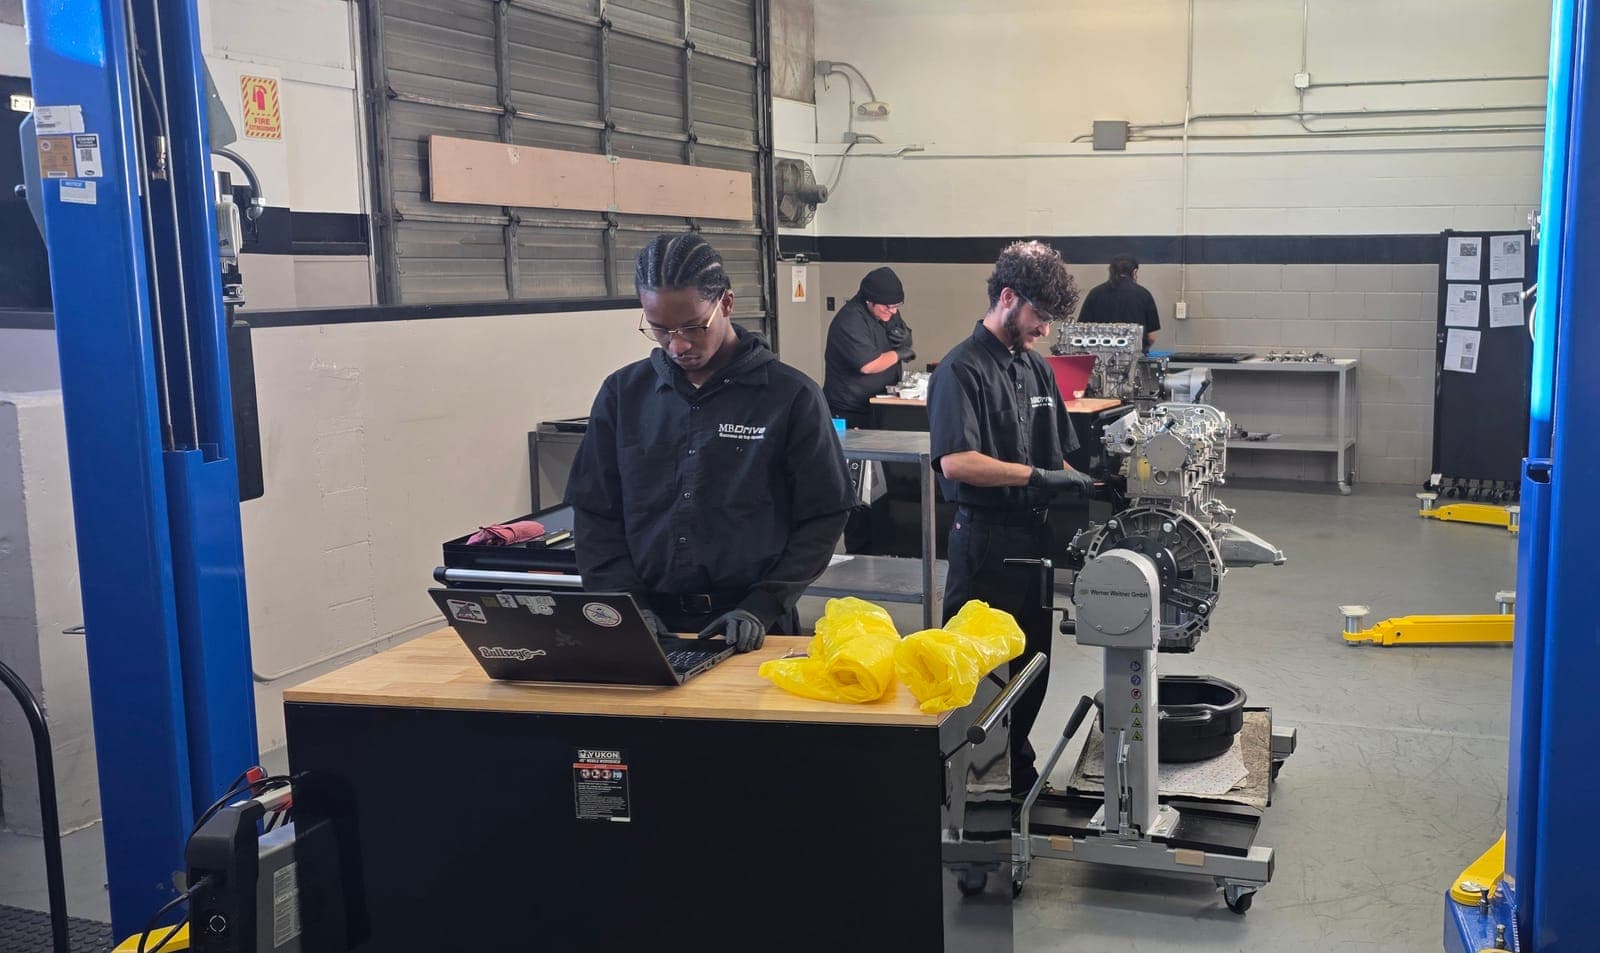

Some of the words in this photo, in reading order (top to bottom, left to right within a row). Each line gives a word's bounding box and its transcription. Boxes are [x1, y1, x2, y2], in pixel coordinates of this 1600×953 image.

[254, 117, 270, 125] FIRE
[719, 423, 766, 434] MBDrive
[588, 751, 619, 759] YUKON
